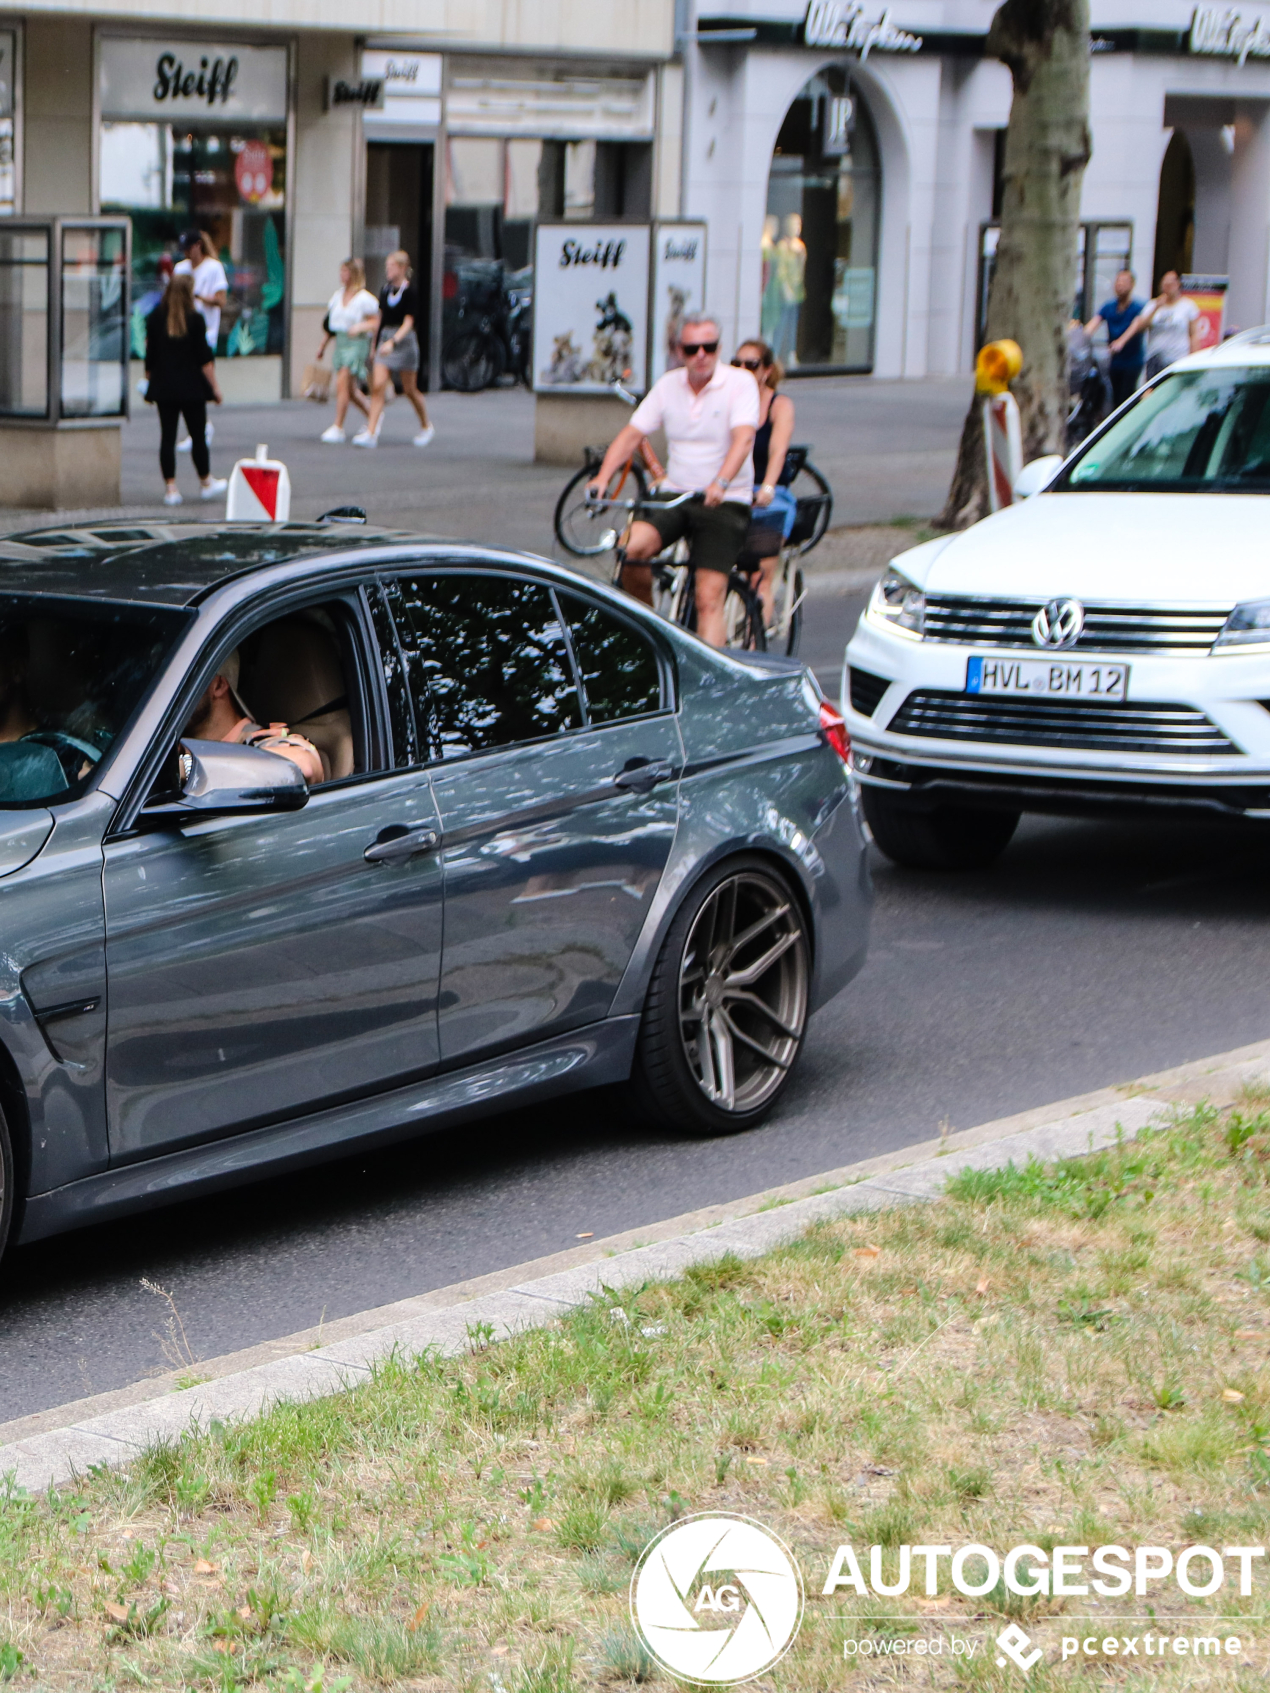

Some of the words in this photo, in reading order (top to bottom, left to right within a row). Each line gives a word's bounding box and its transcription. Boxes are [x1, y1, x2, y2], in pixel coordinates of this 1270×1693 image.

[153, 51, 239, 105] Steiff
[559, 237, 626, 271] Steiff
[983, 659, 1029, 691] HVL
[1049, 663, 1083, 694] BM
[1088, 666, 1124, 696] 12
